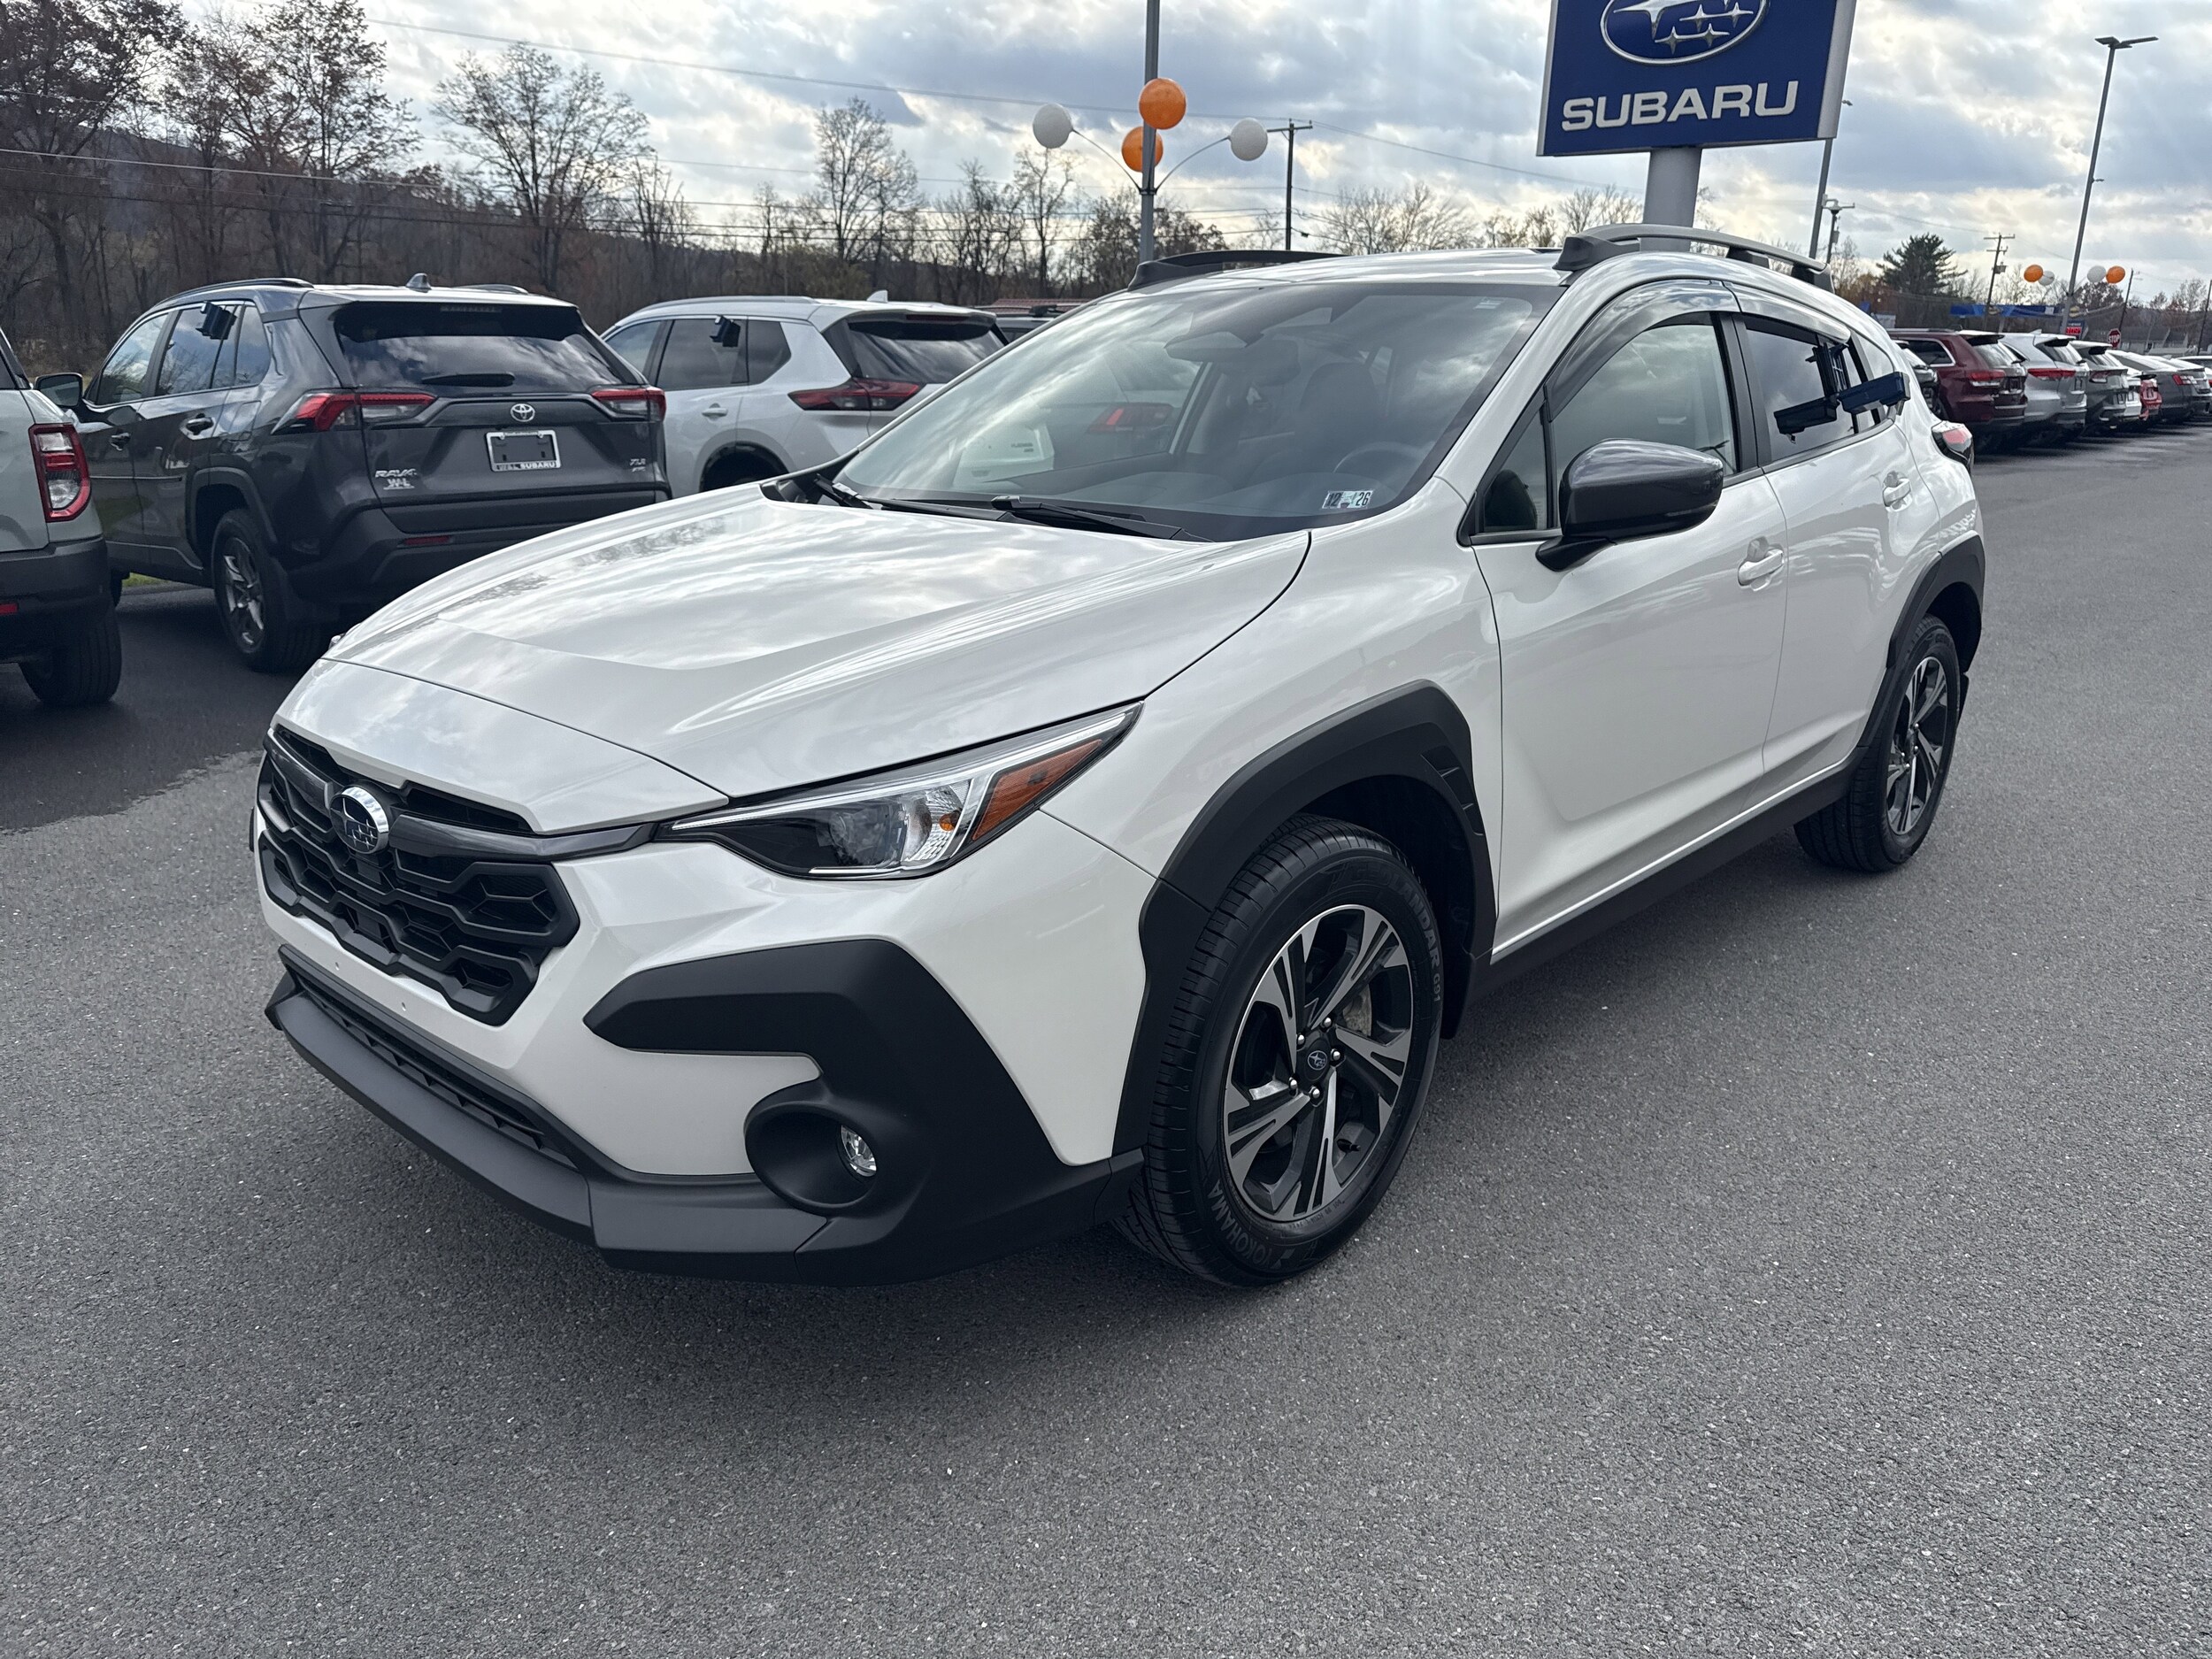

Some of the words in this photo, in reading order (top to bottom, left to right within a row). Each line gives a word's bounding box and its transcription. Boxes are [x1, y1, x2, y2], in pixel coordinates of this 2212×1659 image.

[1562, 81, 1799, 131] SUBARU
[2108, 334, 2120, 343] STOP
[1327, 493, 1342, 506] 12
[1356, 491, 1371, 506] 26
[1207, 1179, 1273, 1266] YOKOHAMA
